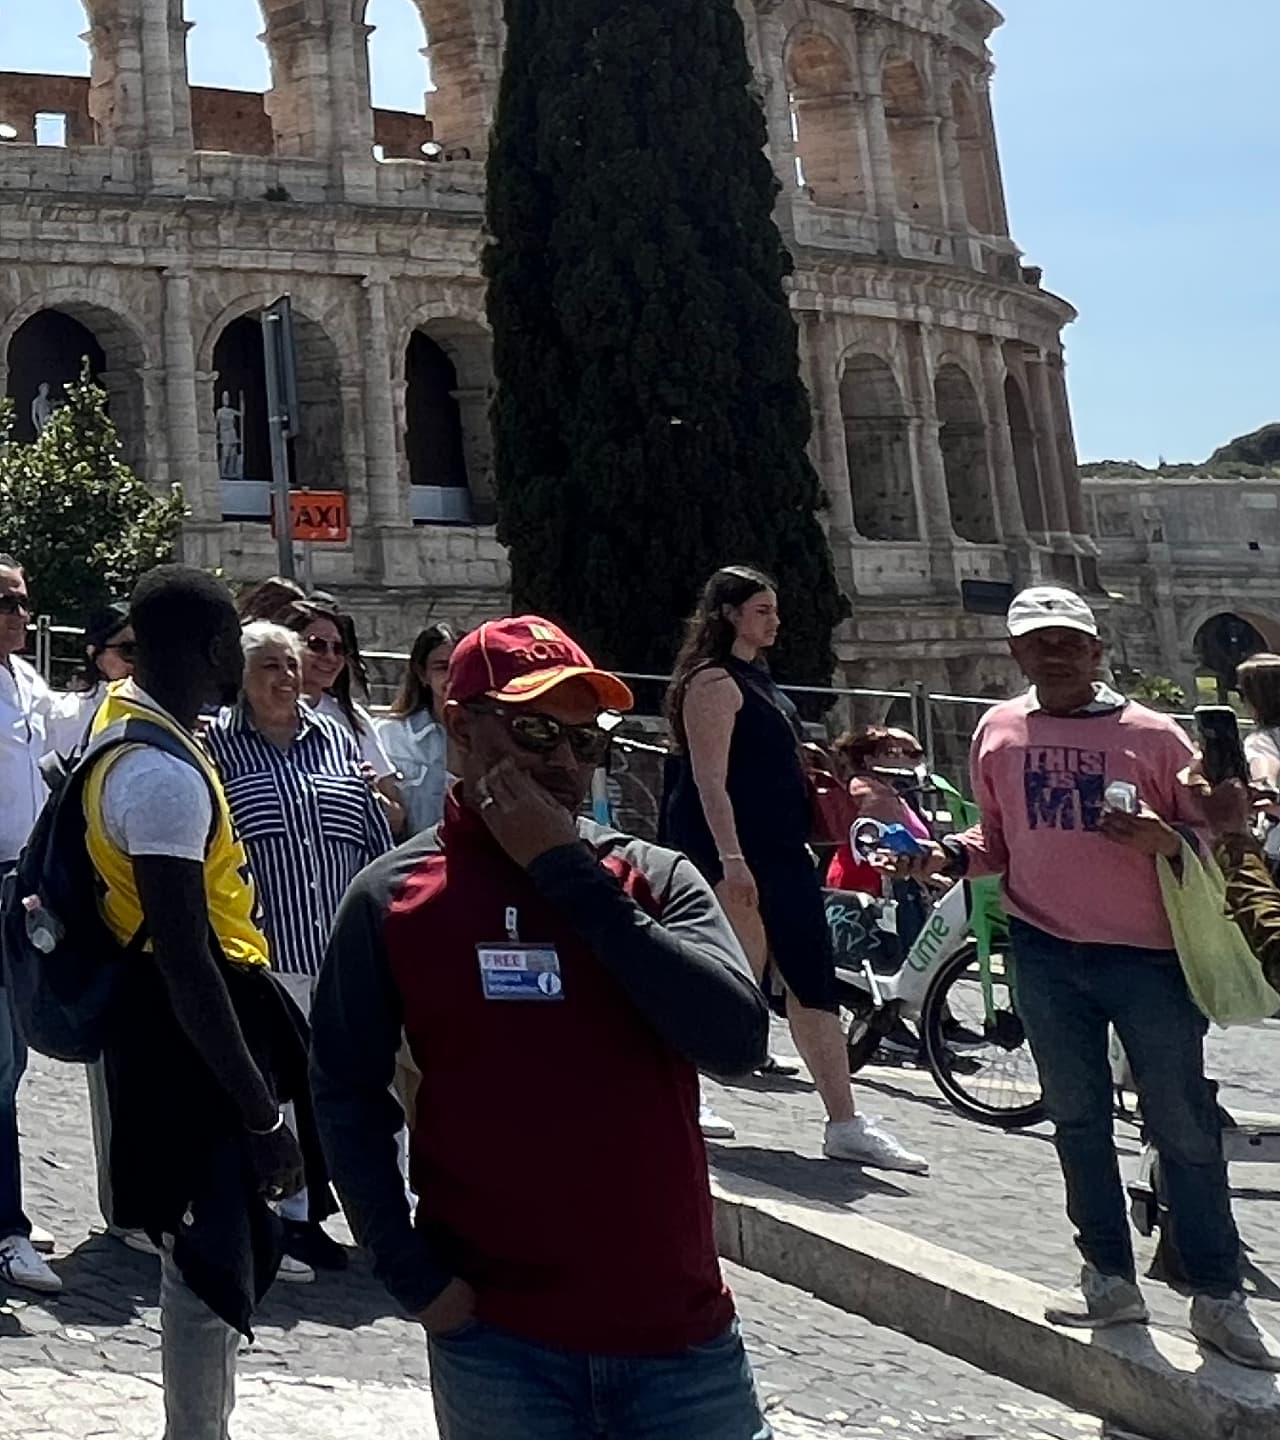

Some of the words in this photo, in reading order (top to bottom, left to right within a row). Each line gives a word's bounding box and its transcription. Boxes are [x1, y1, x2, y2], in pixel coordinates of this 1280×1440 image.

[289, 505, 341, 529] AXI
[1027, 749, 1104, 774] THIS
[909, 914, 951, 973] Lime
